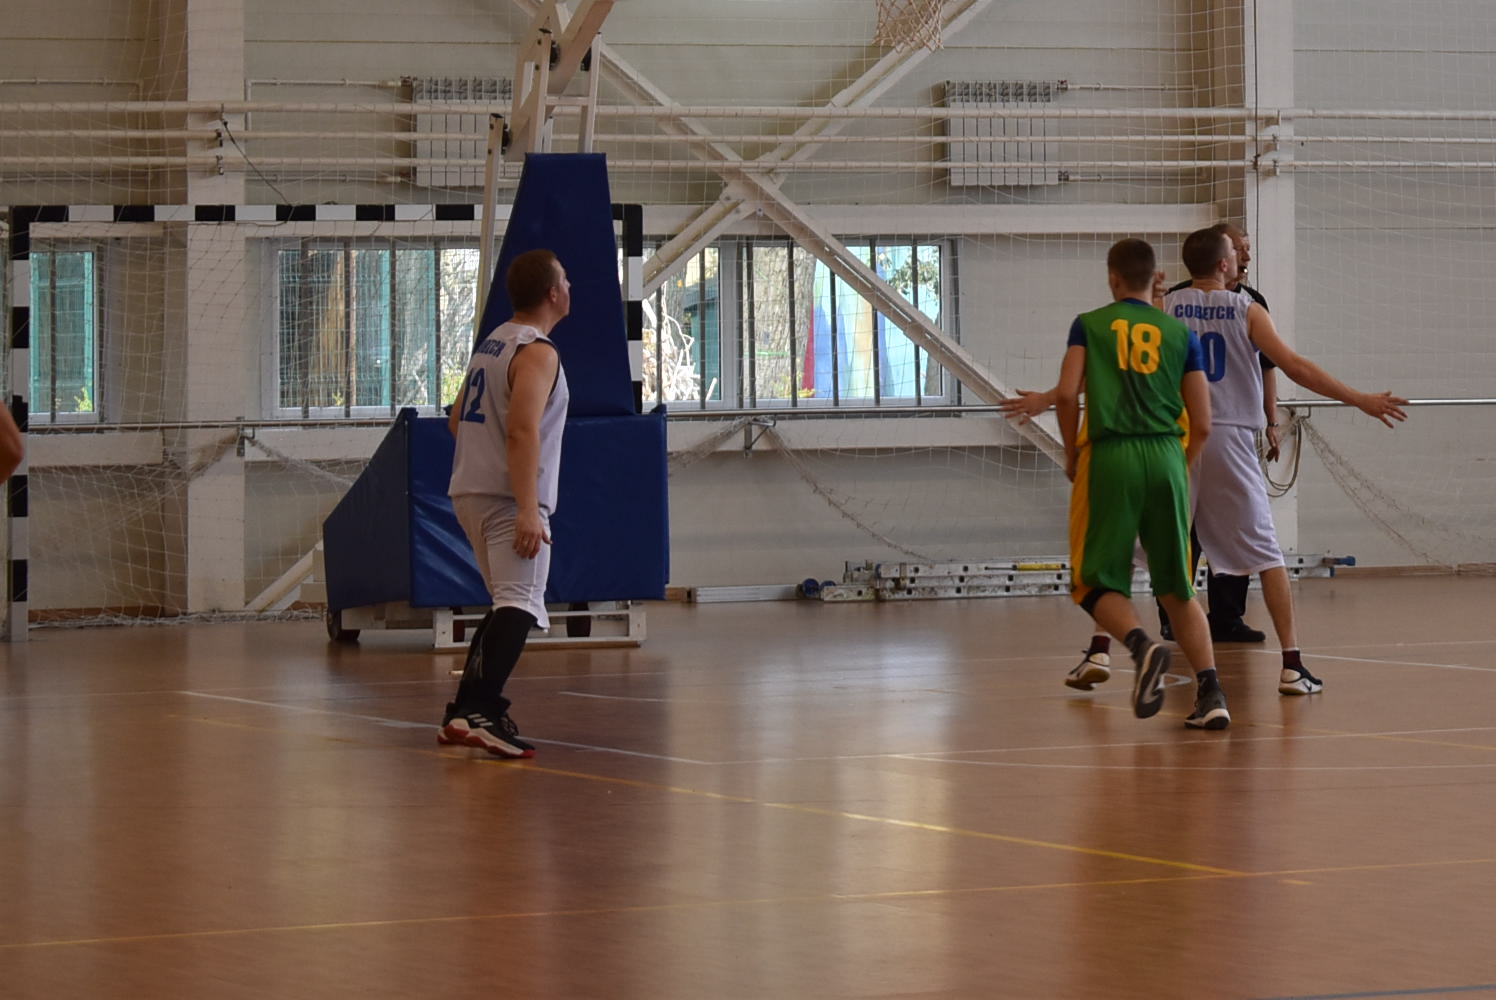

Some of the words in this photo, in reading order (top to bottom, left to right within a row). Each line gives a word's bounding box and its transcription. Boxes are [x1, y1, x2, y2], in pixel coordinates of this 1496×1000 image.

[1175, 304, 1235, 320] СОВЕТСК
[1110, 318, 1162, 374] 18
[1194, 331, 1226, 383] 0
[460, 367, 486, 424] 12
